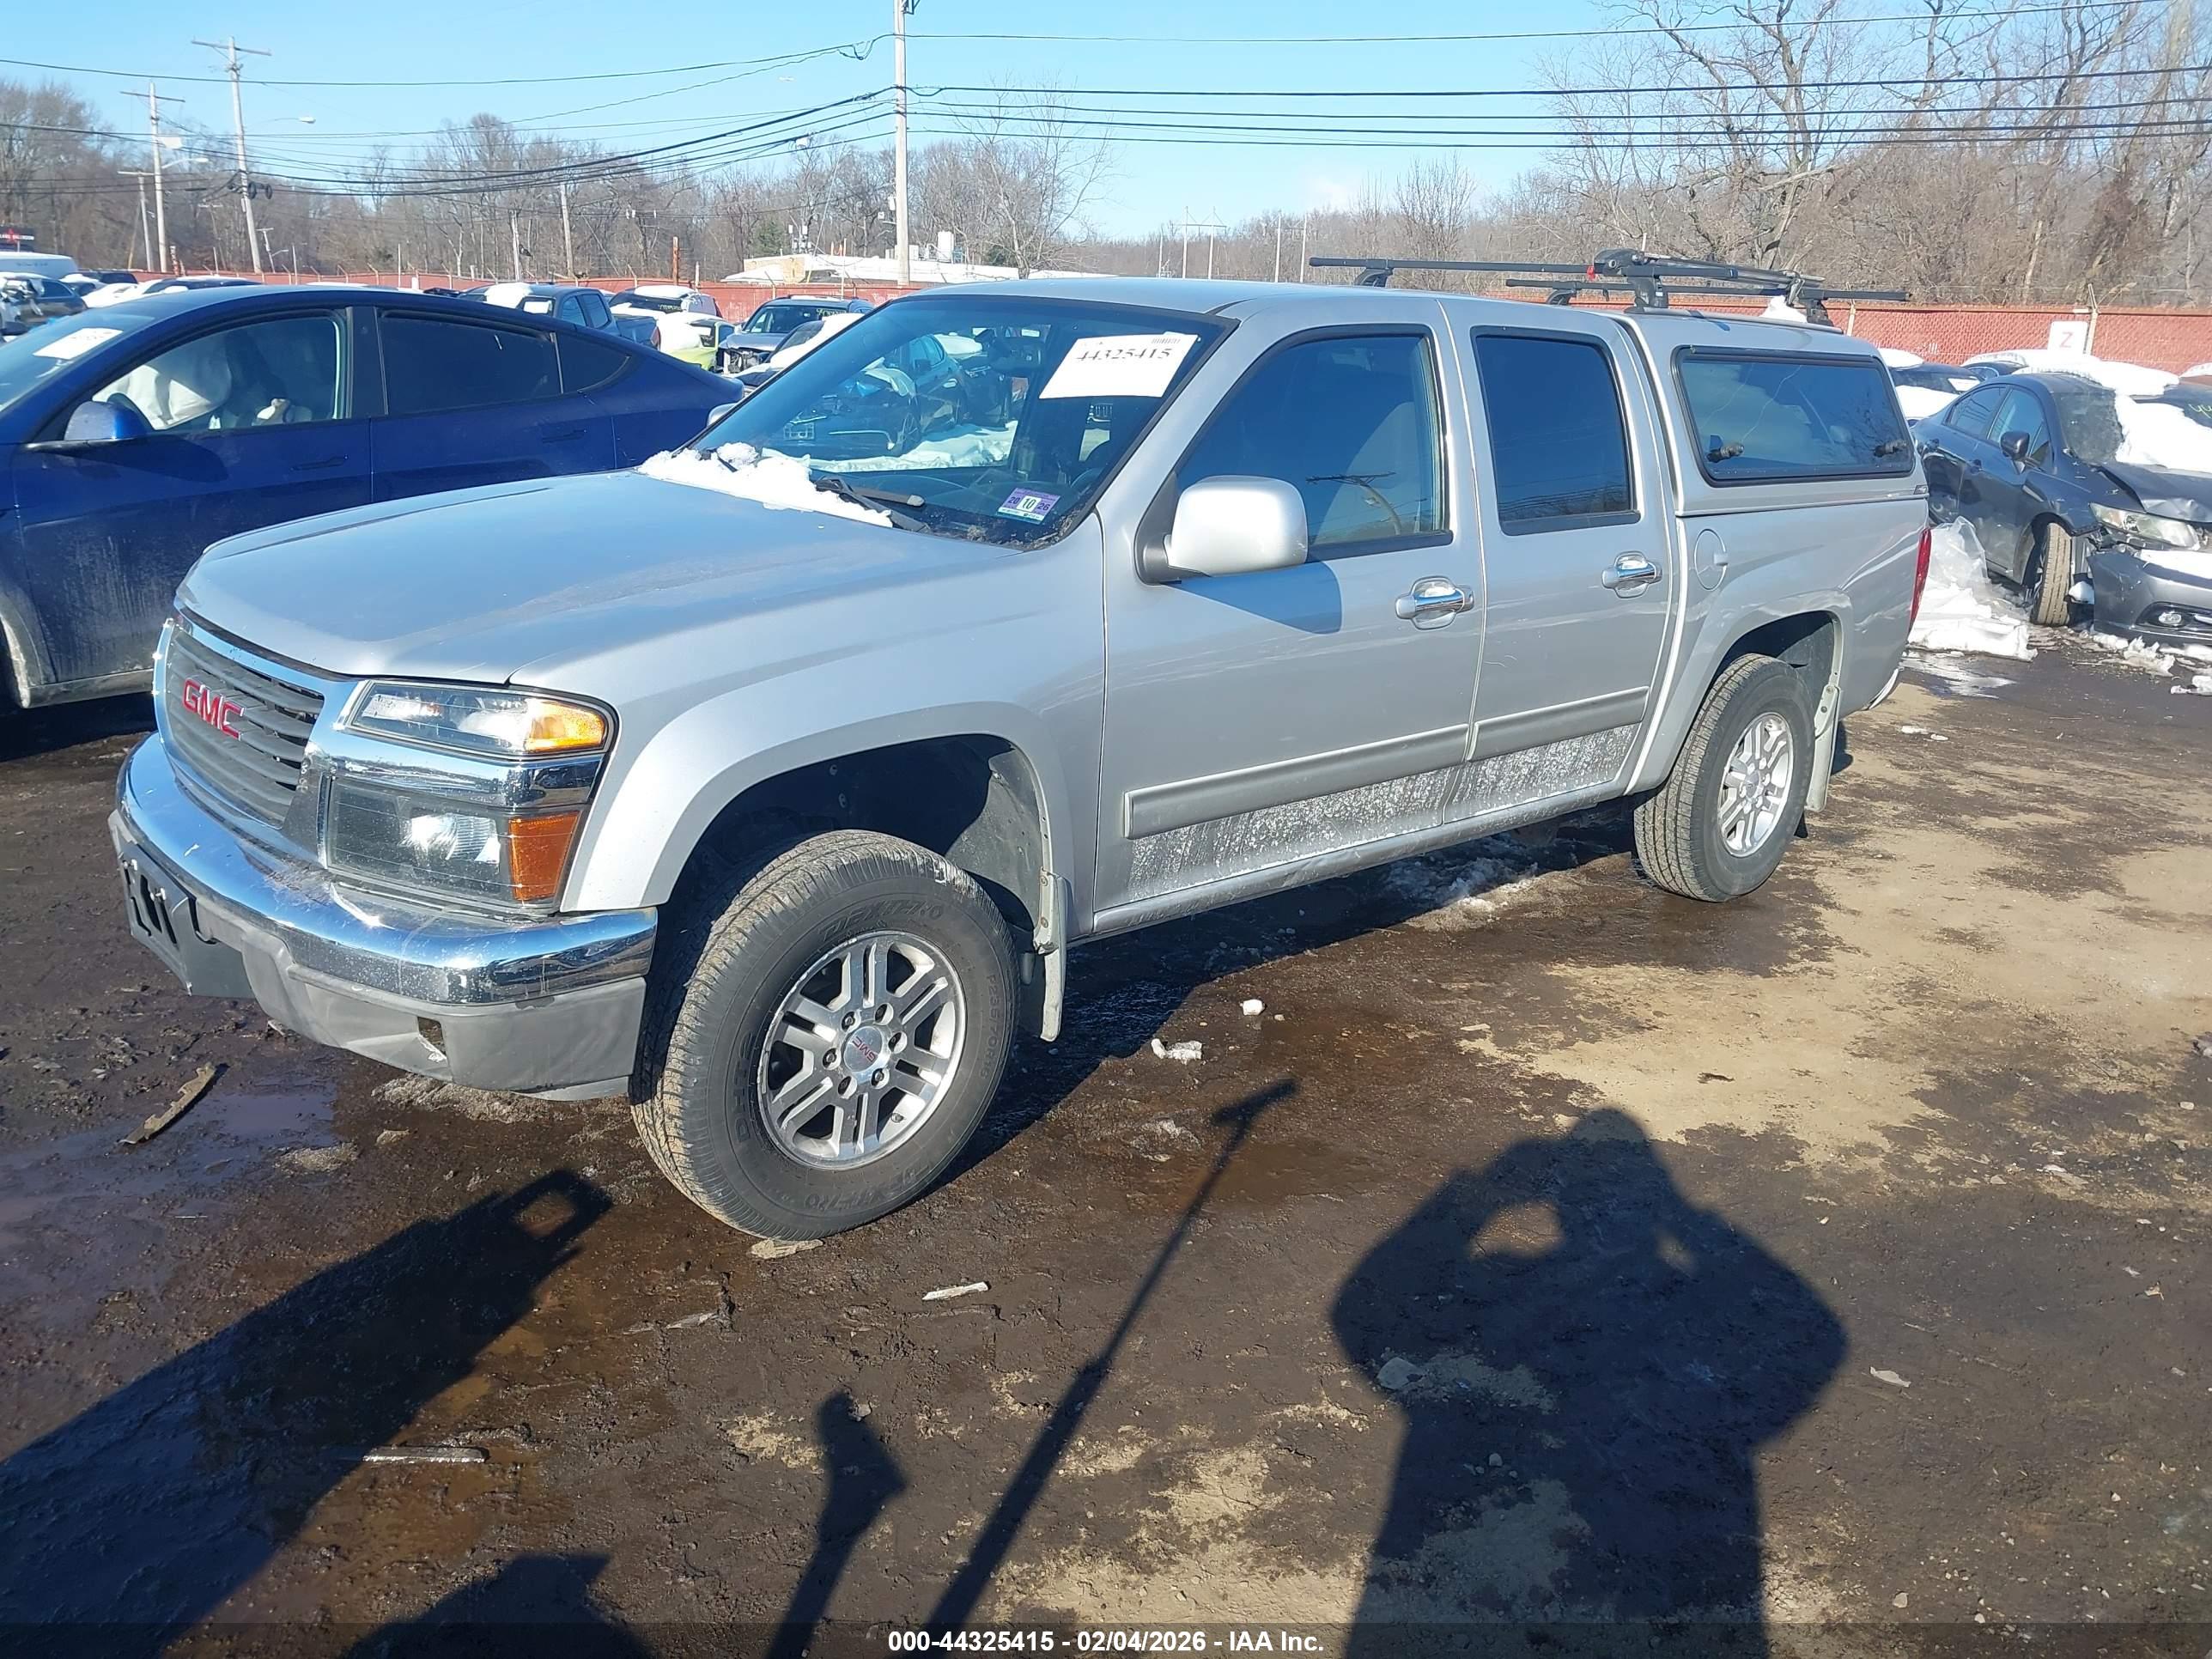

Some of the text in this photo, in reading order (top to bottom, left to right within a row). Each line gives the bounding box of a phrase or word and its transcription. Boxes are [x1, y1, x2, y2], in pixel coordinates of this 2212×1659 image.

[2059, 331, 2074, 349] Z
[1076, 347, 1173, 362] 44325415
[1007, 496, 1051, 511] 20 10 26
[182, 677, 246, 741] GMC
[852, 1036, 877, 1063] GMC
